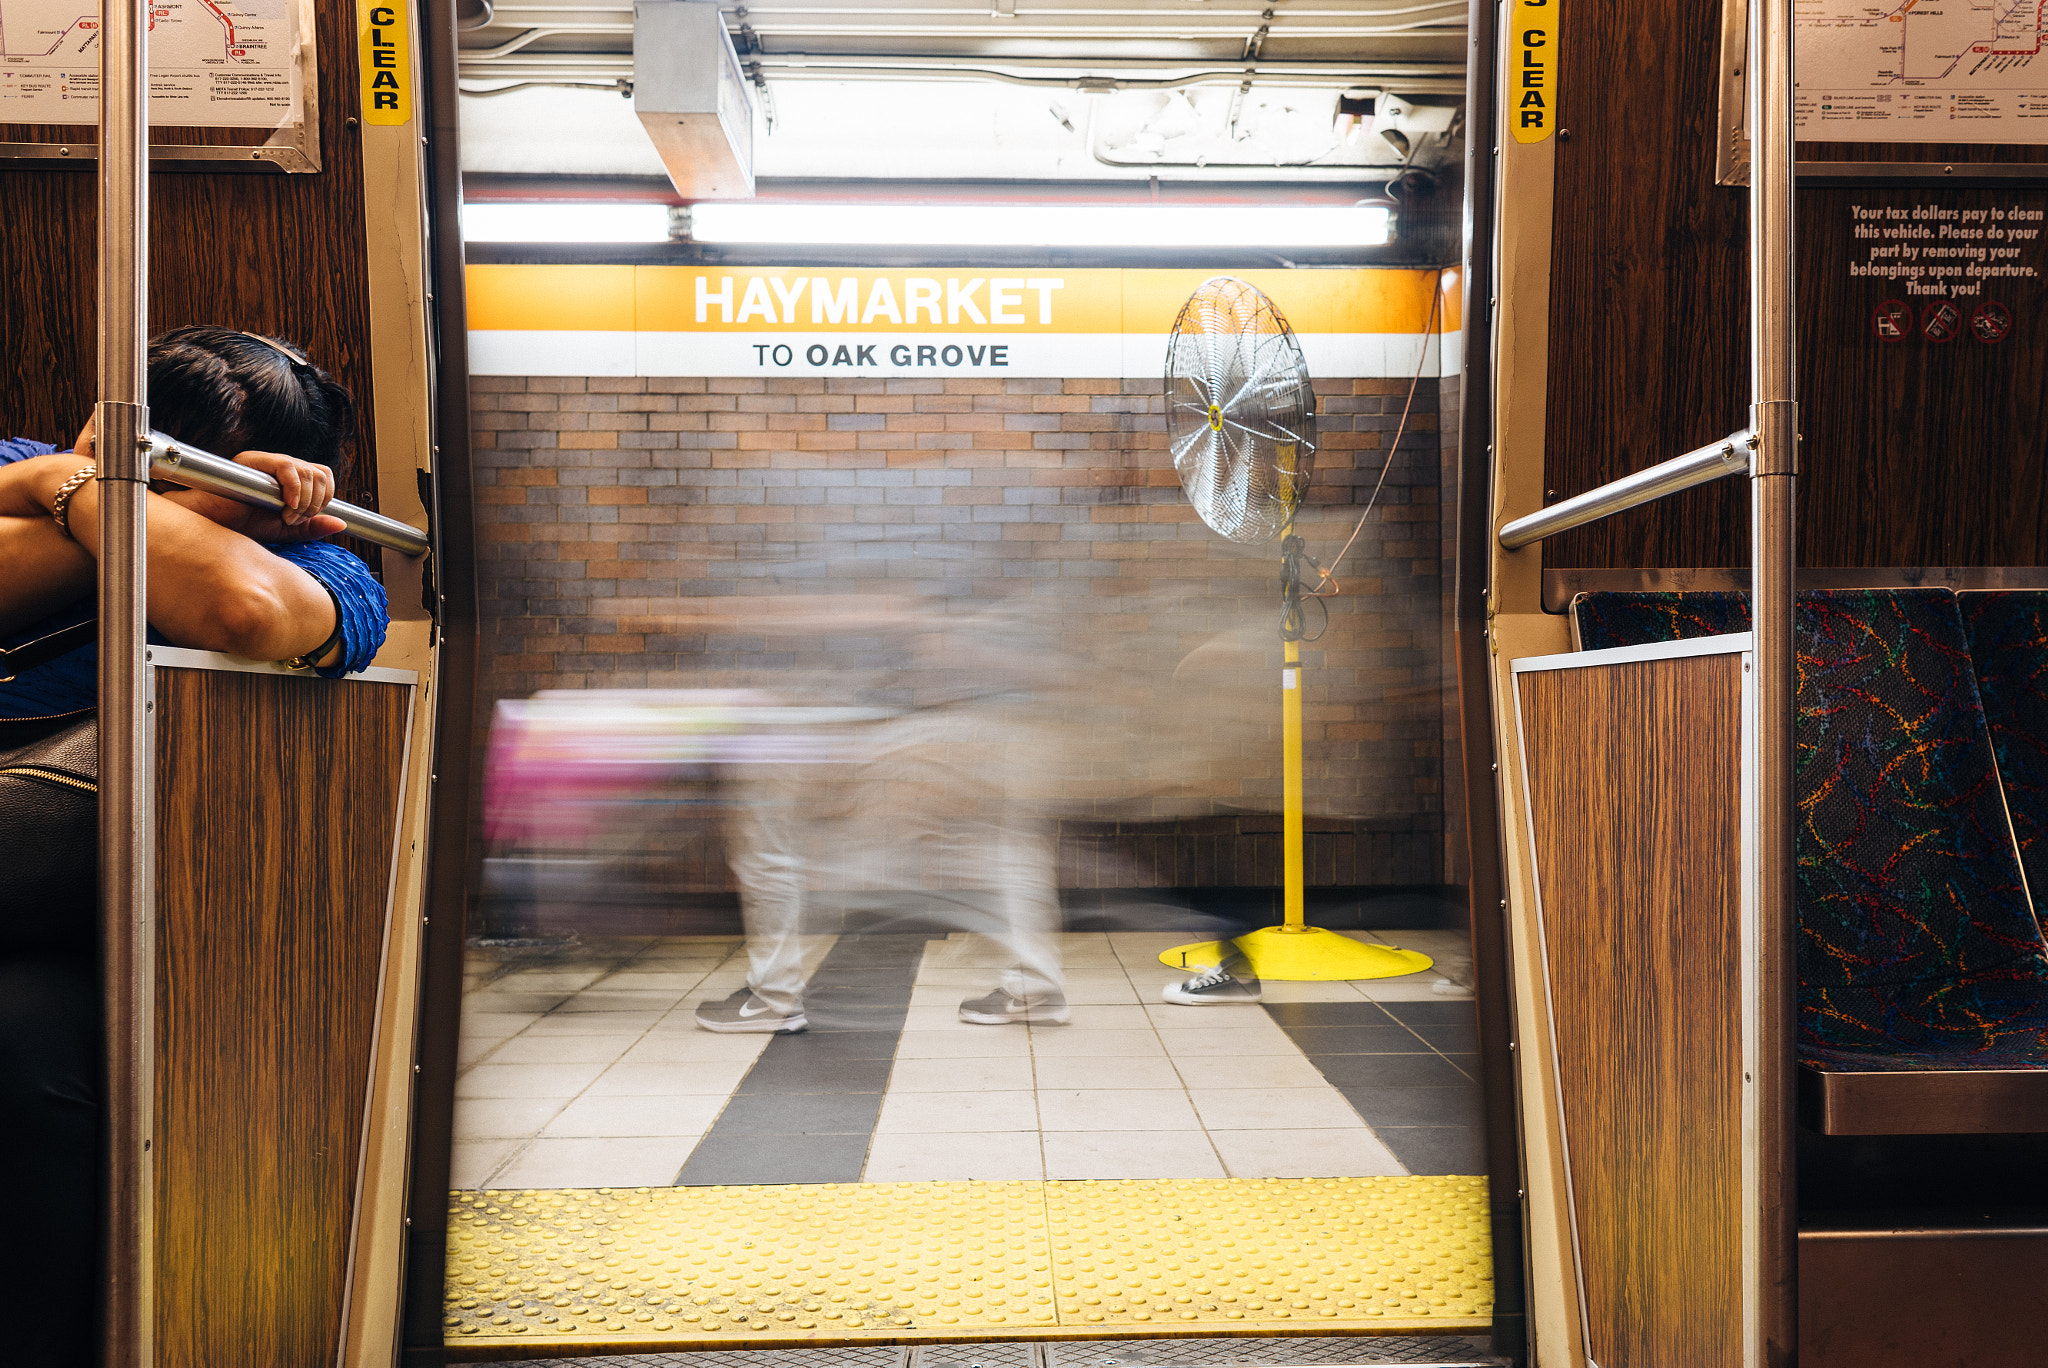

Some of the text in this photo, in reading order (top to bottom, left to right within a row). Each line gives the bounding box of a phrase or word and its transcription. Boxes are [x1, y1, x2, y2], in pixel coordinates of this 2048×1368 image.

[370, 7, 400, 109] CLEAR
[1520, 30, 1546, 128] CLEAR
[1852, 205, 2043, 223] Your tax dollars pay to clean
[1855, 224, 2038, 242] this vehicle. Please do your
[1871, 243, 2020, 261] part by removing your
[1850, 261, 2038, 280] belongings upon departure.
[1906, 280, 1980, 298] Thank you!
[696, 276, 1064, 324] HAYMARKET
[753, 344, 1008, 366] TO OAK GROVE
